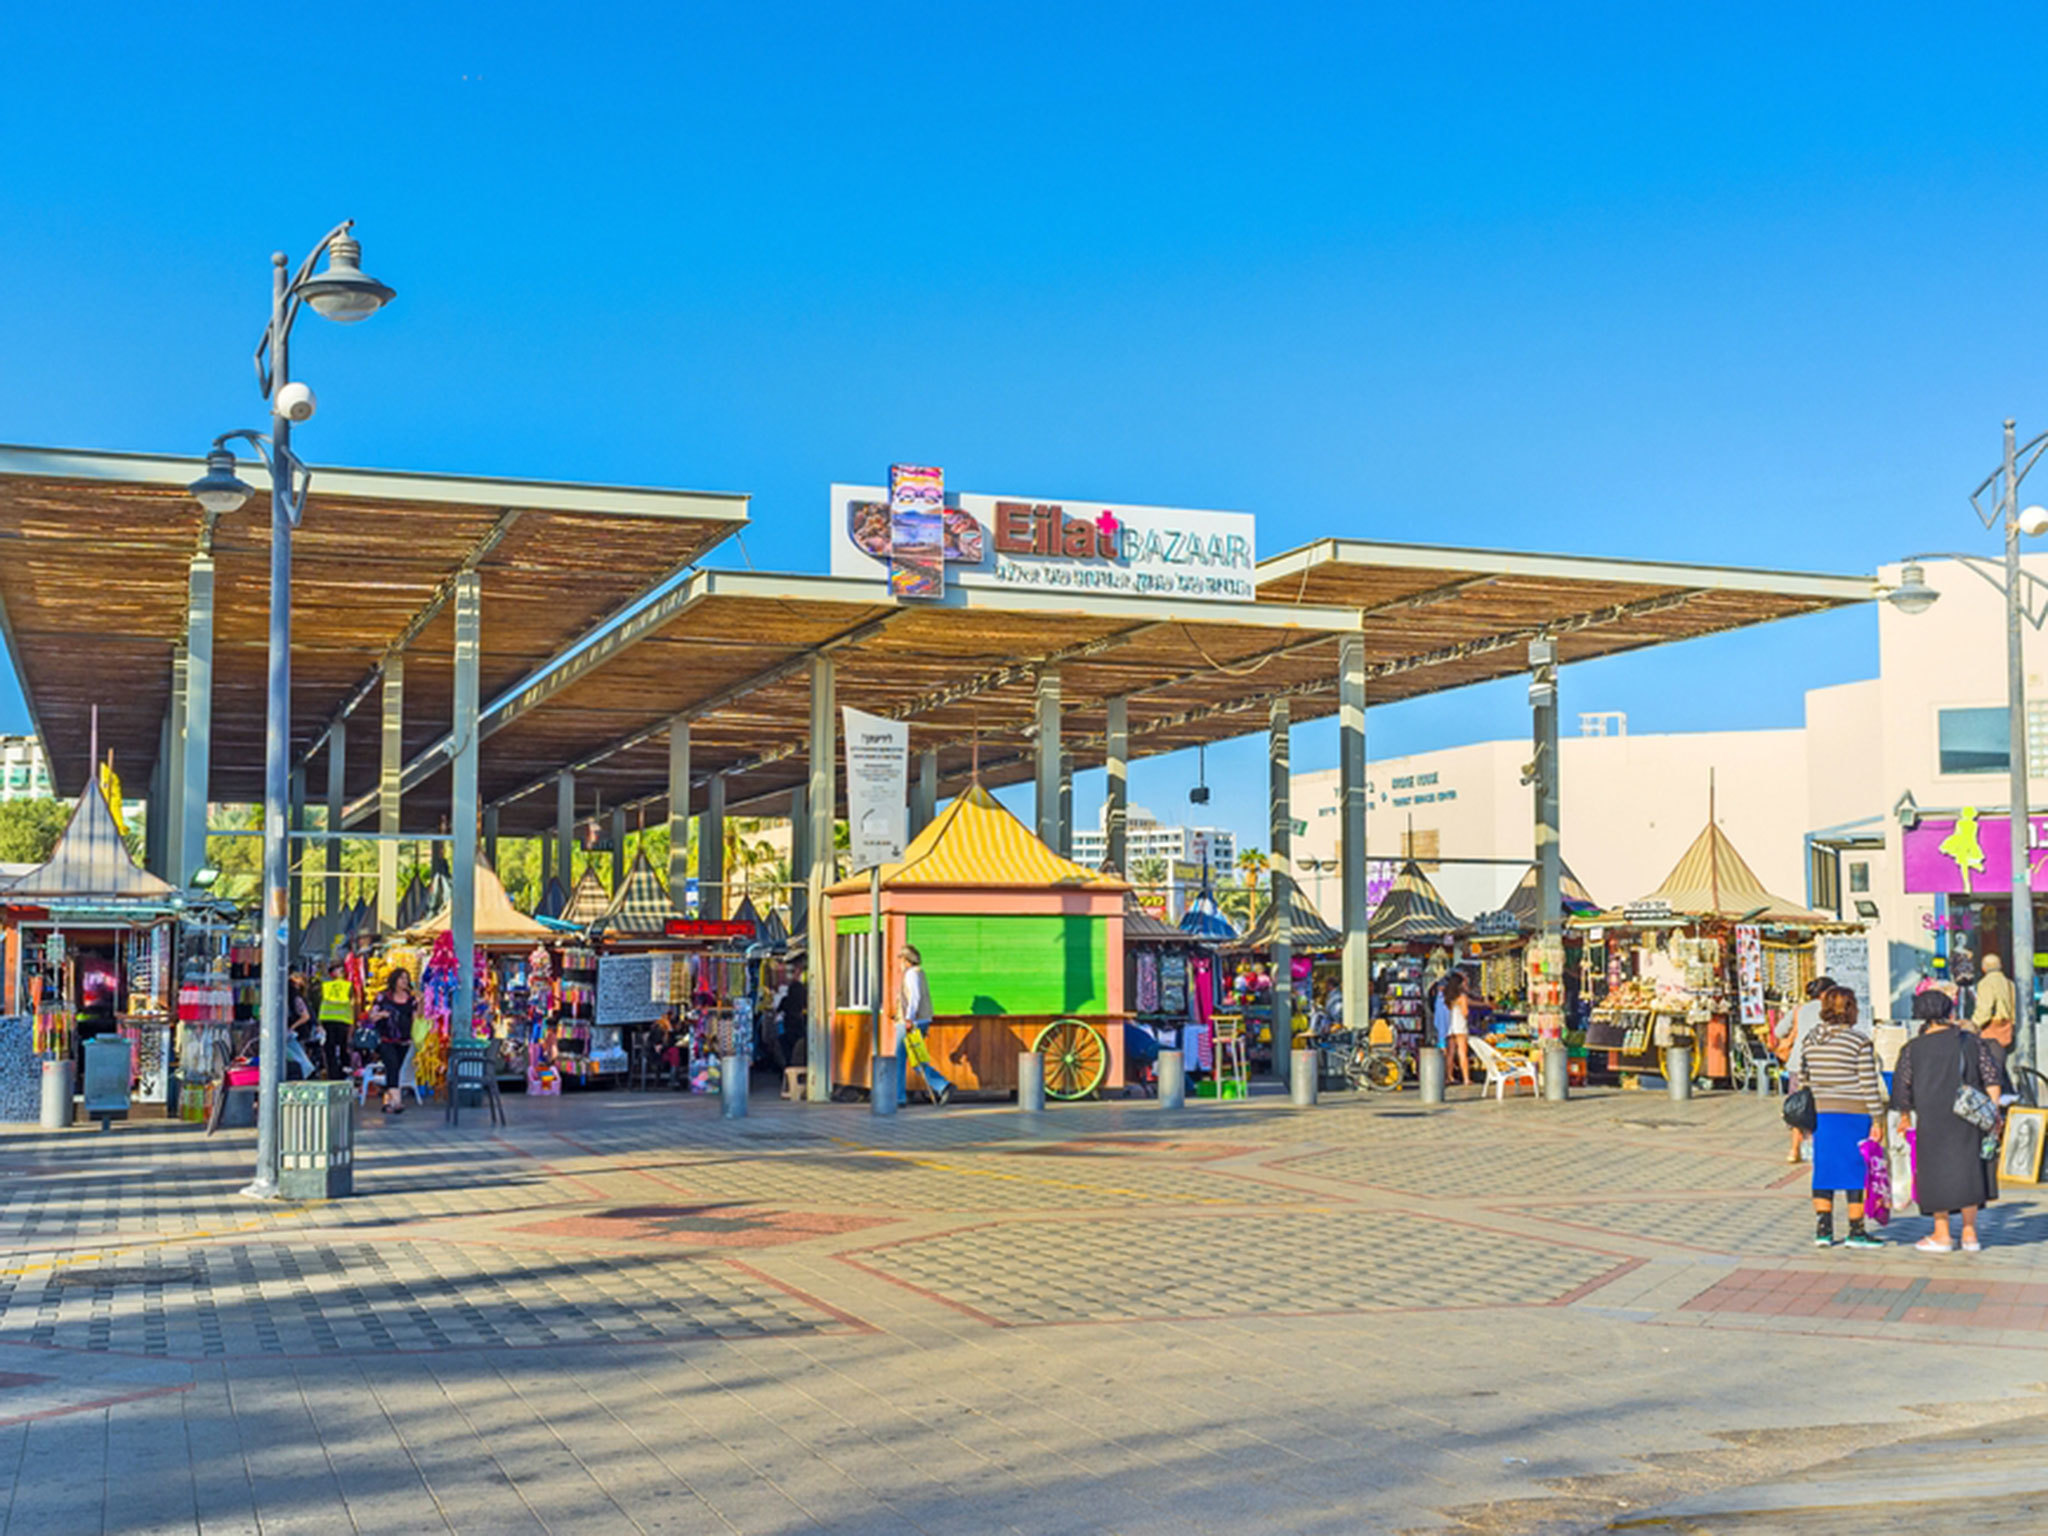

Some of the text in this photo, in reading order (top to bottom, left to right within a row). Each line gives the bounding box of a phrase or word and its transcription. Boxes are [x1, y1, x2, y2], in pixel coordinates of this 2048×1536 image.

[995, 501, 1249, 567] Eilat BAZAAR
[1922, 912, 1973, 931] SALE
